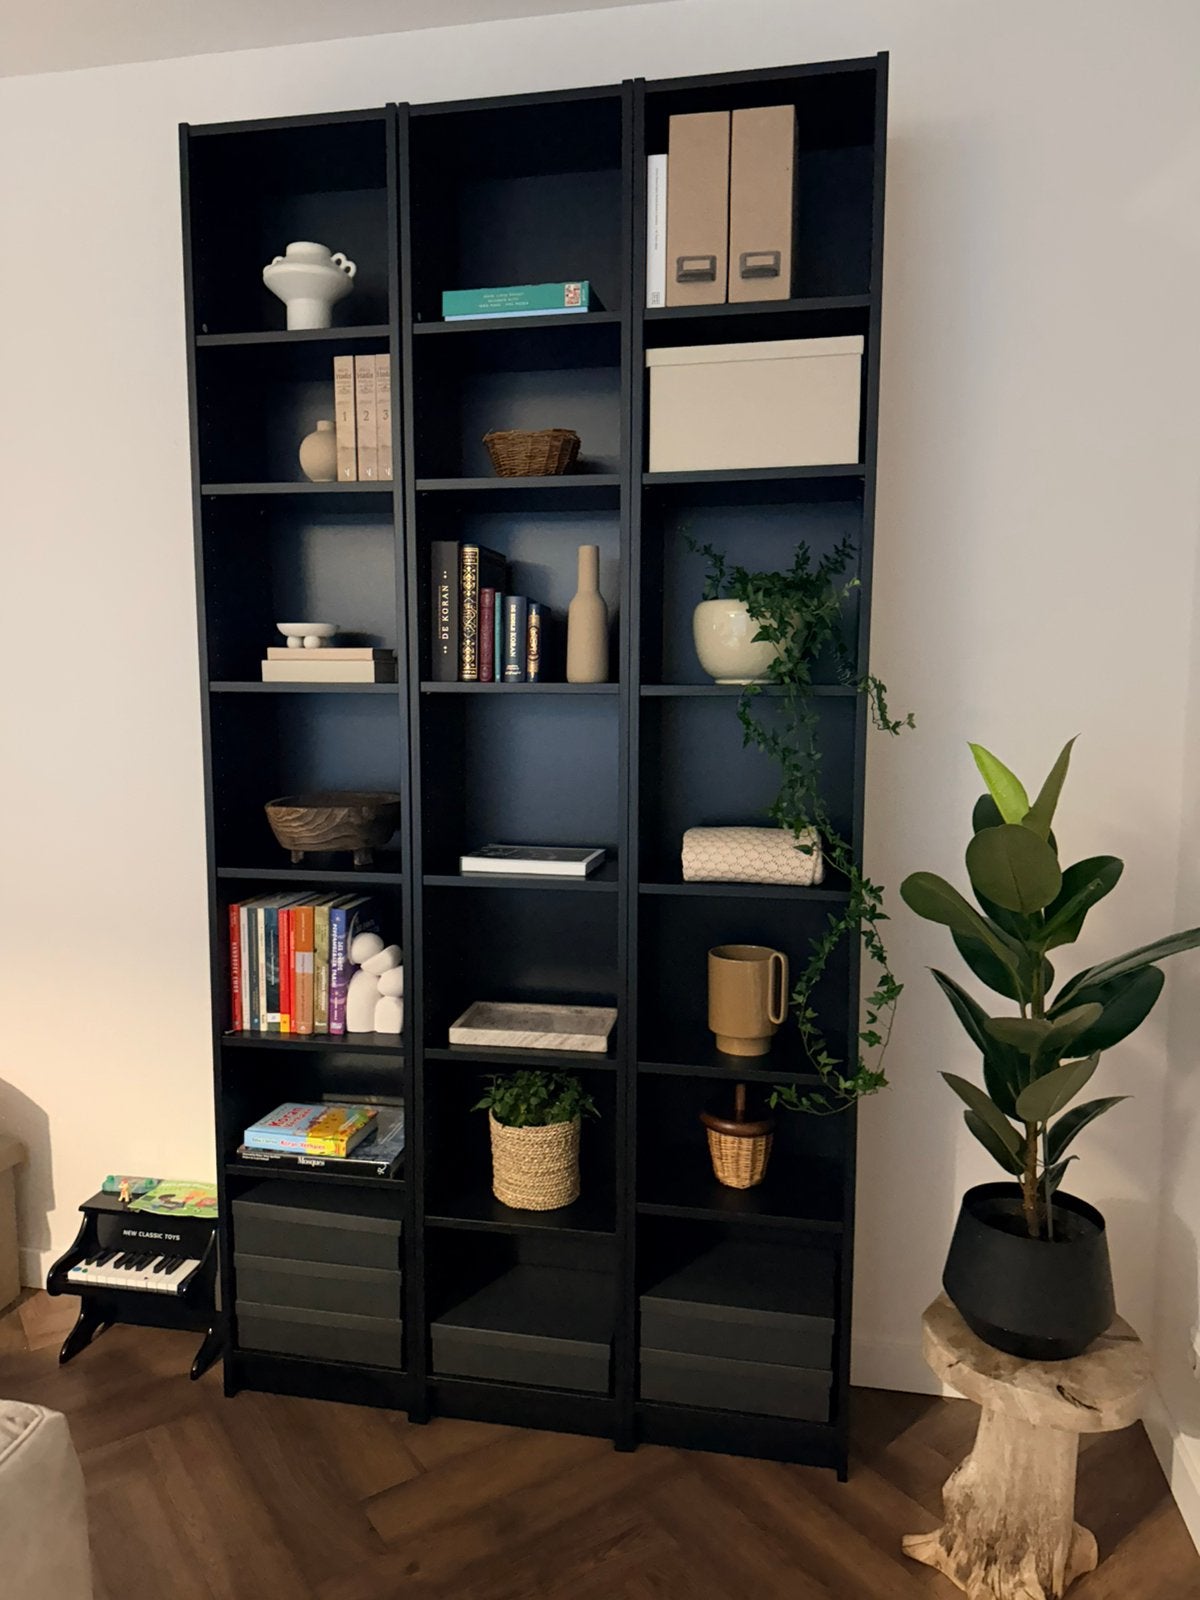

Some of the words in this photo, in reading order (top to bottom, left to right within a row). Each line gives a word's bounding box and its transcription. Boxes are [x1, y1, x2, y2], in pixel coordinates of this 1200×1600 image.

[343, 411, 347, 422] 1
[363, 410, 370, 421] 2
[382, 409, 389, 421] 3
[441, 585, 449, 622] KORAN
[441, 626, 449, 640] DE
[297, 1156, 325, 1167] Mosques
[138, 1231, 163, 1239] CLASSIC
[164, 1233, 180, 1241] TOYS
